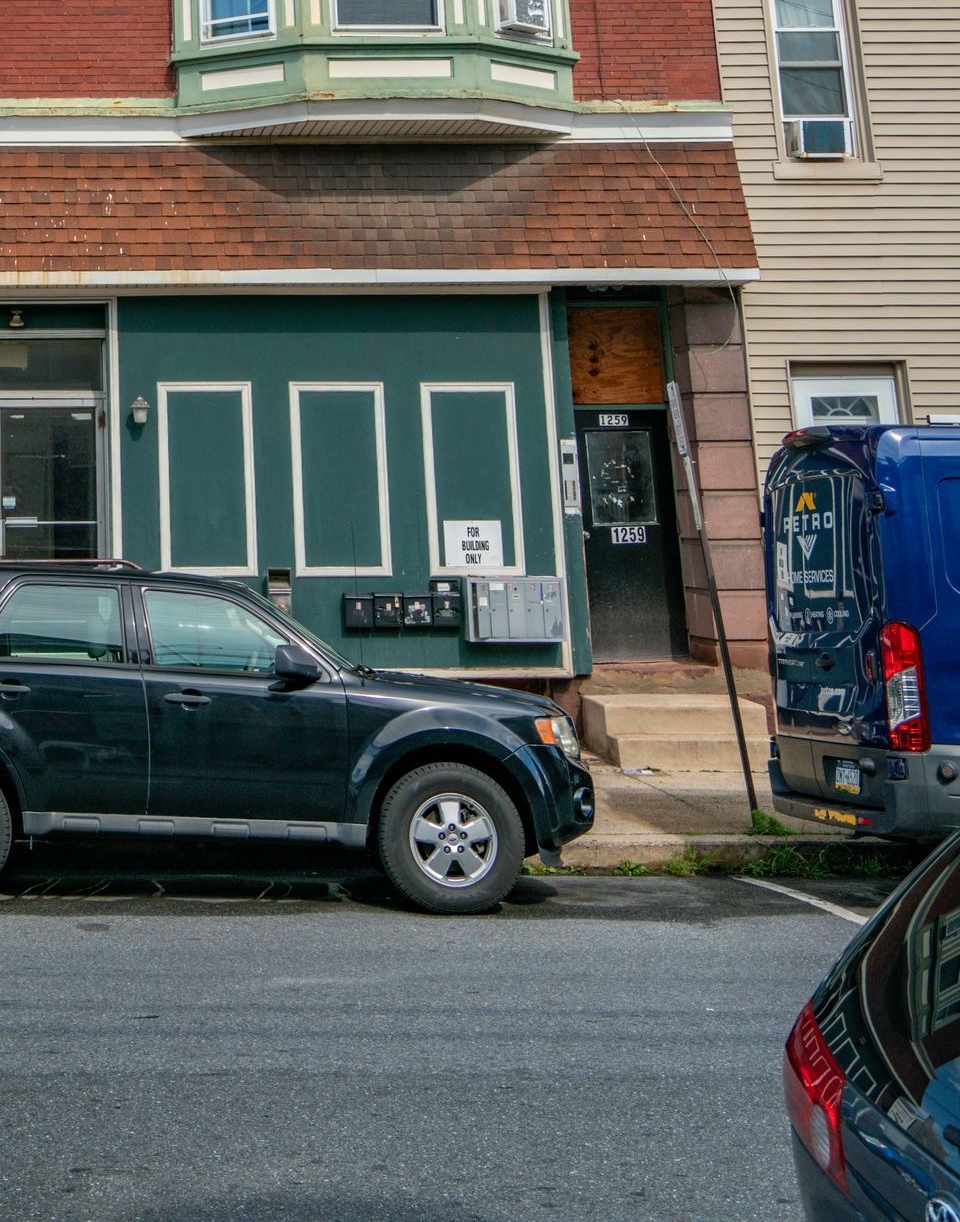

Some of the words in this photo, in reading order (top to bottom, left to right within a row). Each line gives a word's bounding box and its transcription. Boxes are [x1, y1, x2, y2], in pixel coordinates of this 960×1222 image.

[601, 415, 628, 425] 1259
[783, 511, 833, 534] PETRO
[467, 527, 480, 537] FOR
[613, 527, 645, 543] 1259
[462, 540, 490, 551] BUILDING
[465, 553, 482, 564] ONLY
[804, 569, 834, 583] SERVICES
